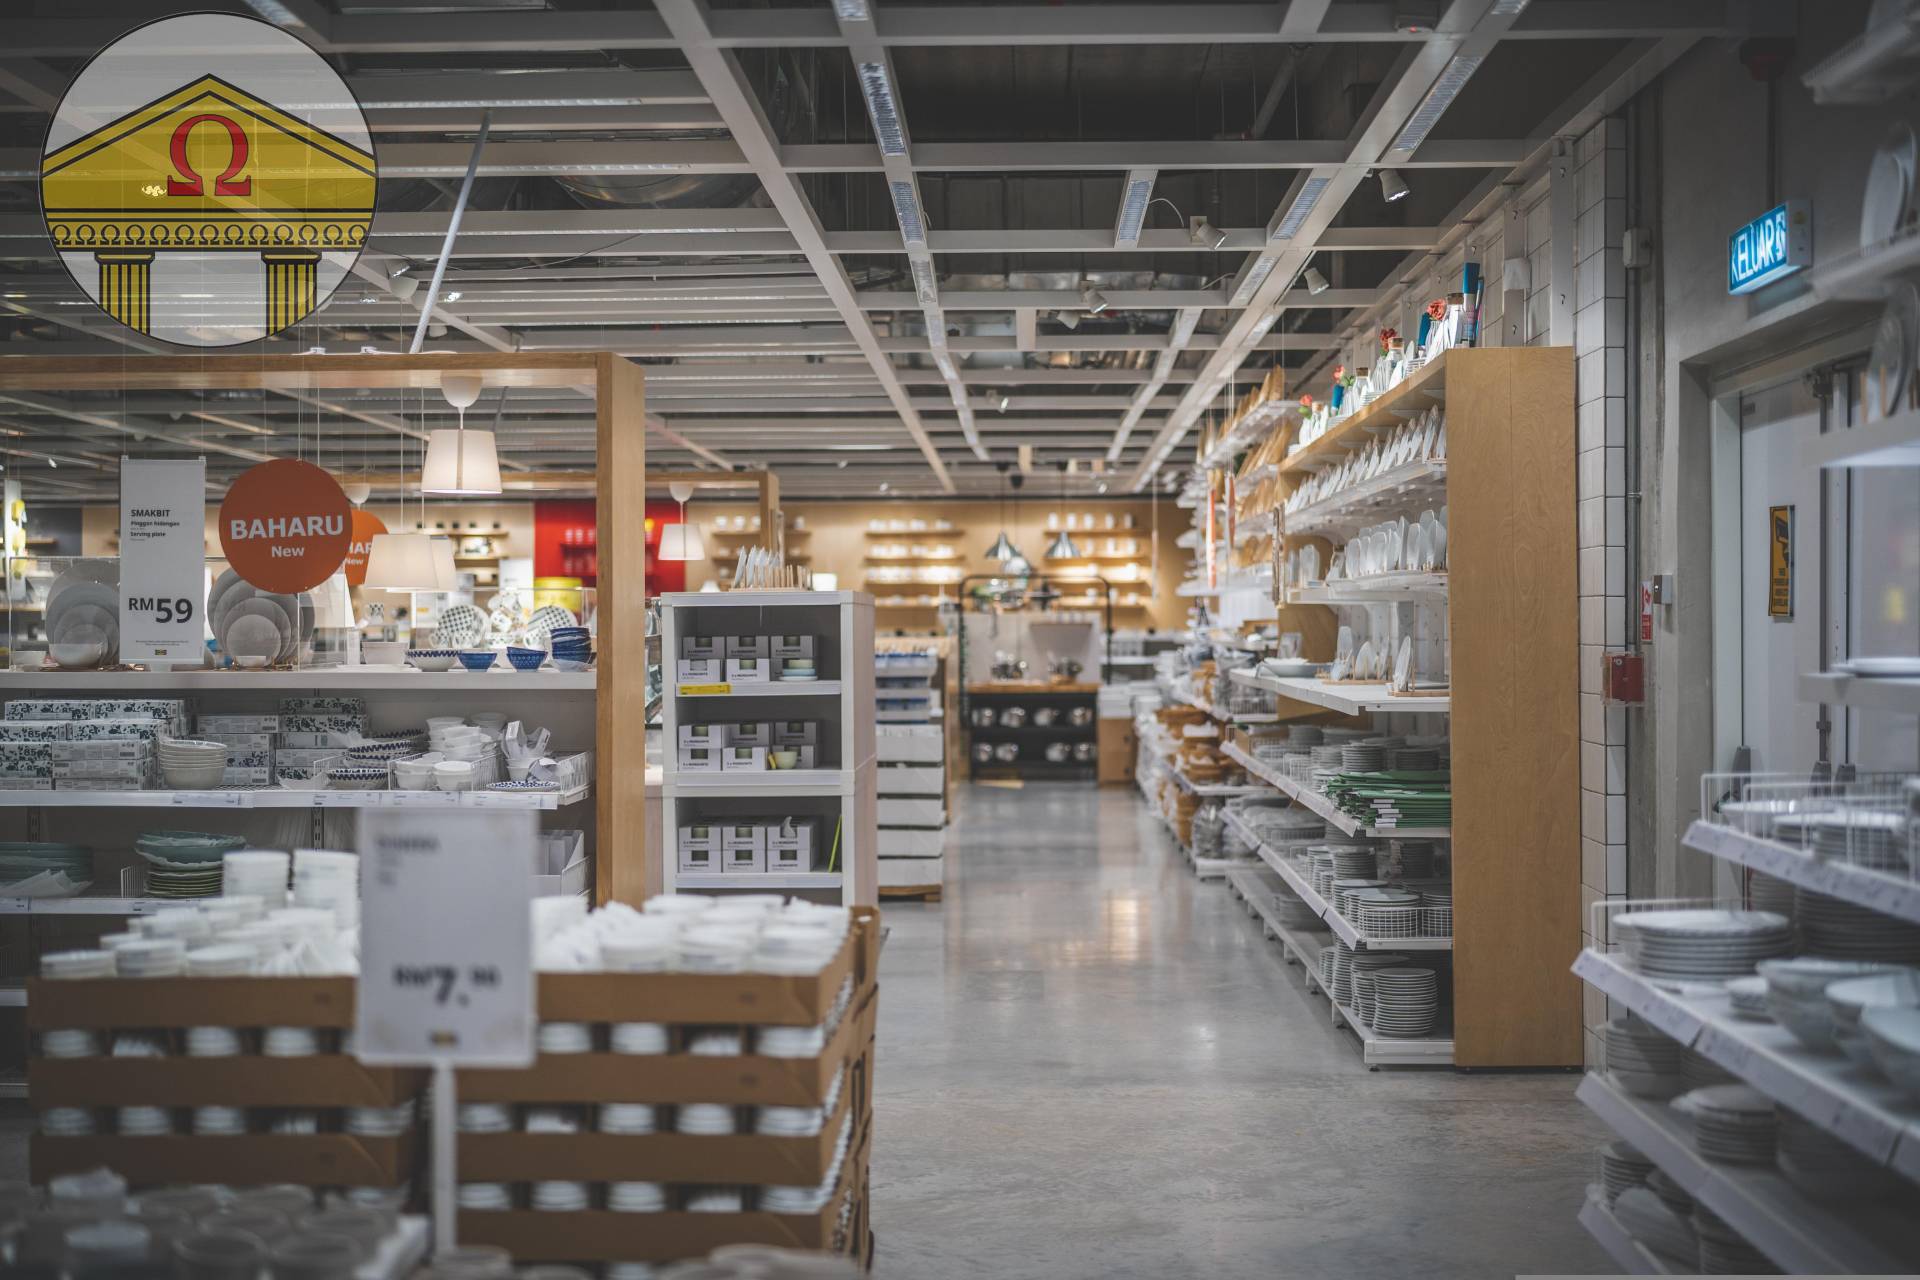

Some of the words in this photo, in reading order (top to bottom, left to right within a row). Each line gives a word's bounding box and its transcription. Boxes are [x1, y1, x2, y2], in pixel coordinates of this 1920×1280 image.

[1731, 218, 1775, 285] KELUAR
[130, 509, 171, 517] SMAKBIT
[230, 515, 344, 540] BAHARU
[271, 545, 304, 558] New
